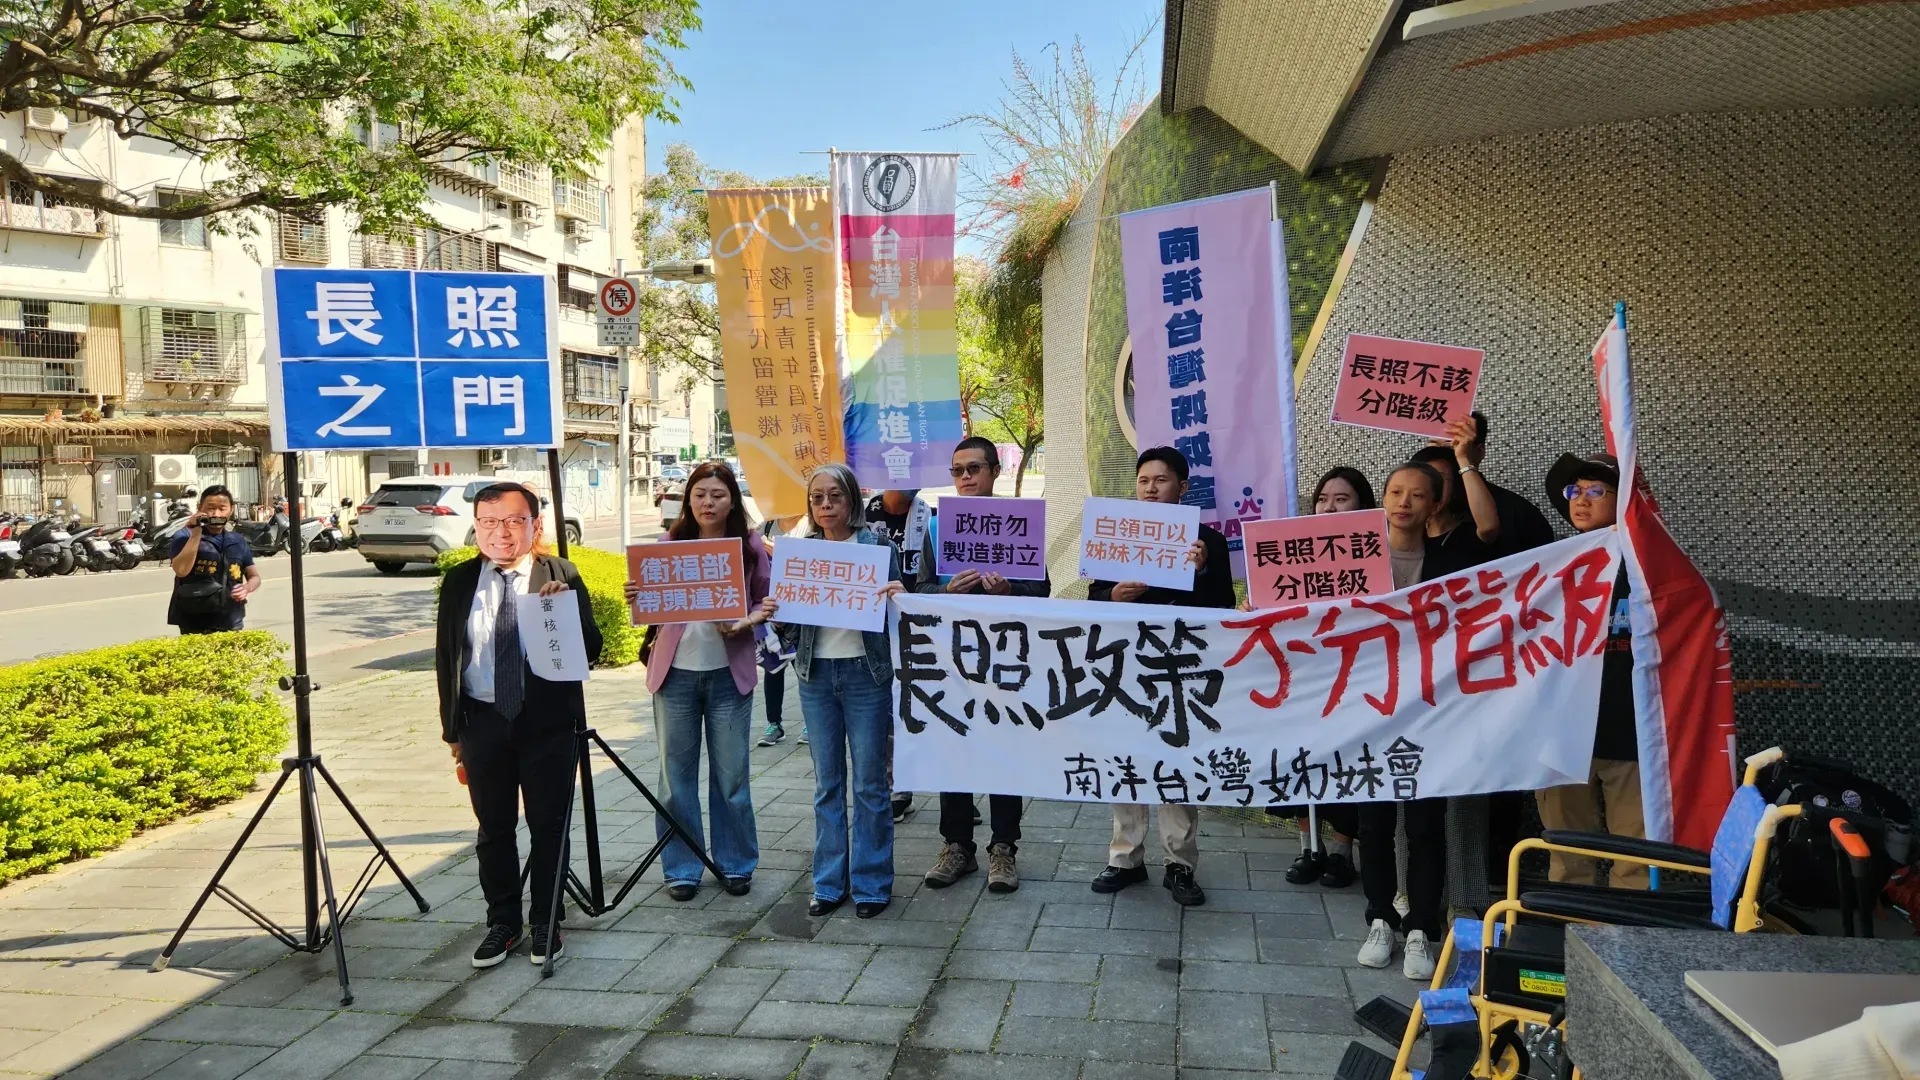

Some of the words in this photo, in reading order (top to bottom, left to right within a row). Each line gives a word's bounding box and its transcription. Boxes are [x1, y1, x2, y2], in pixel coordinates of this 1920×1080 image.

[869, 224, 914, 480] 台灣人權促進會
[910, 256, 919, 296] TAIWAN
[919, 419, 929, 451] RIGHTS
[1349, 354, 1473, 394] 長照不該
[1356, 388, 1449, 424] 分階級
[955, 513, 1028, 537] 政府勿
[1095, 516, 1187, 544] 白領可以
[943, 540, 1040, 567] 製造對立
[1253, 531, 1383, 568] 長照不該
[640, 553, 732, 584] 衛福部
[784, 557, 878, 584] 白領可以
[1272, 568, 1370, 600] 分階級
[636, 586, 740, 614] 帶頭違法
[540, 598, 565, 671] 審核名單
[1064, 736, 1425, 805] 南洋台灣姊妹會
